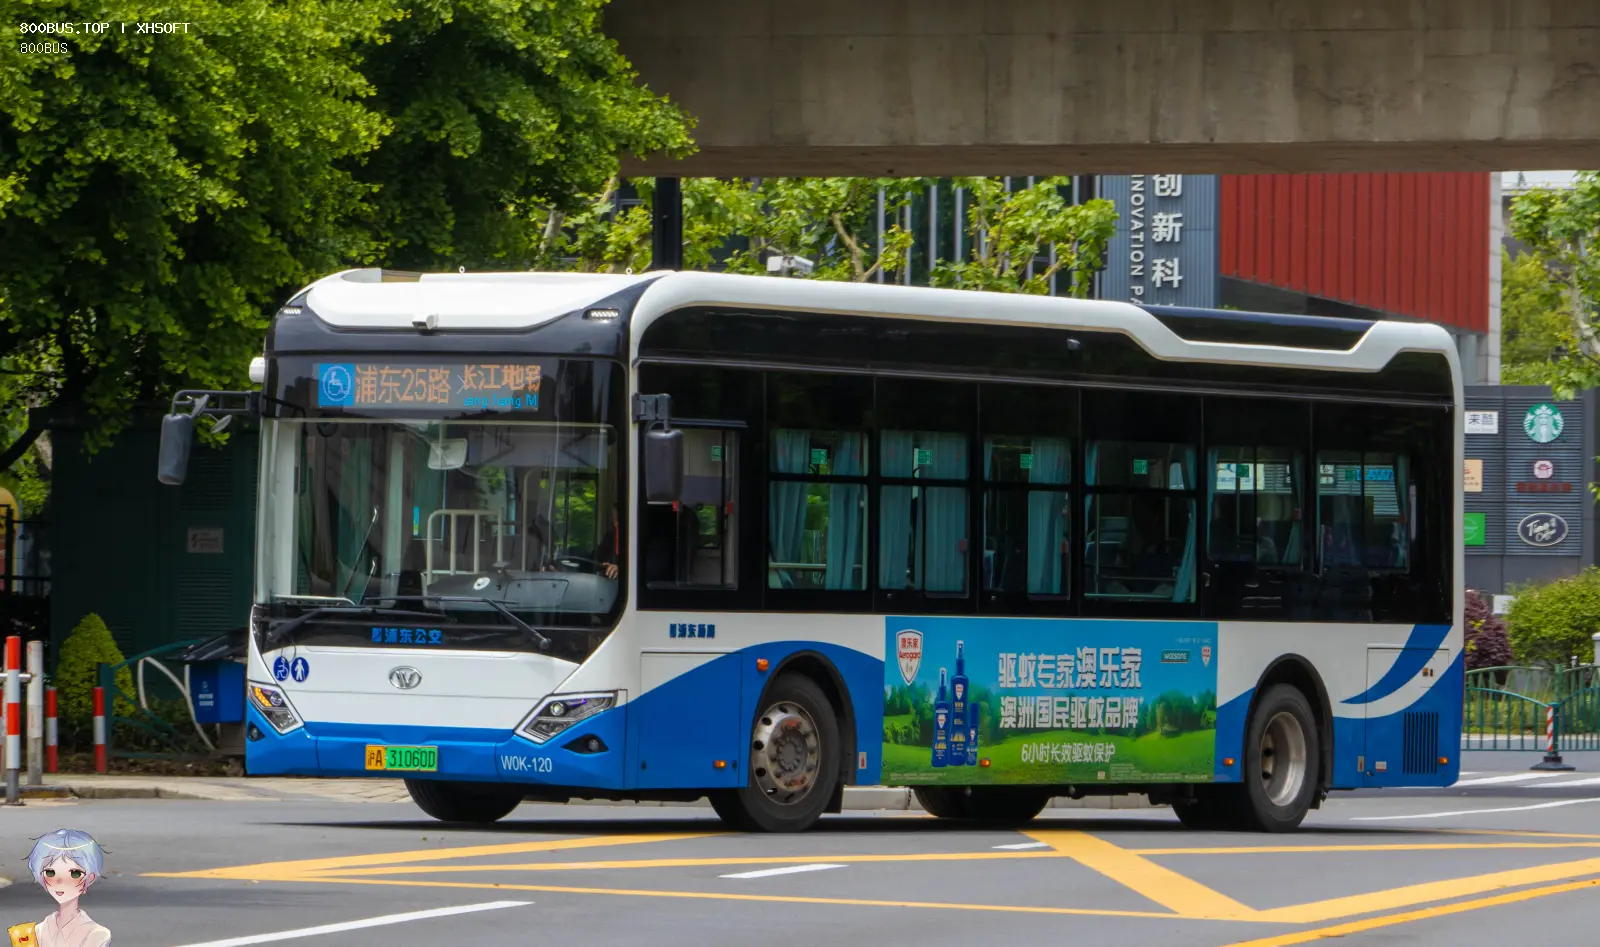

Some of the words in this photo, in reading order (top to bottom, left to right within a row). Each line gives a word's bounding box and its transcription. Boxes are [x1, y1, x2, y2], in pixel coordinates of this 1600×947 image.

[355, 365, 451, 404] 浦东25路
[384, 626, 442, 645] 浦东公交
[1021, 742, 1116, 763] 6小时长效驱蚊保护
